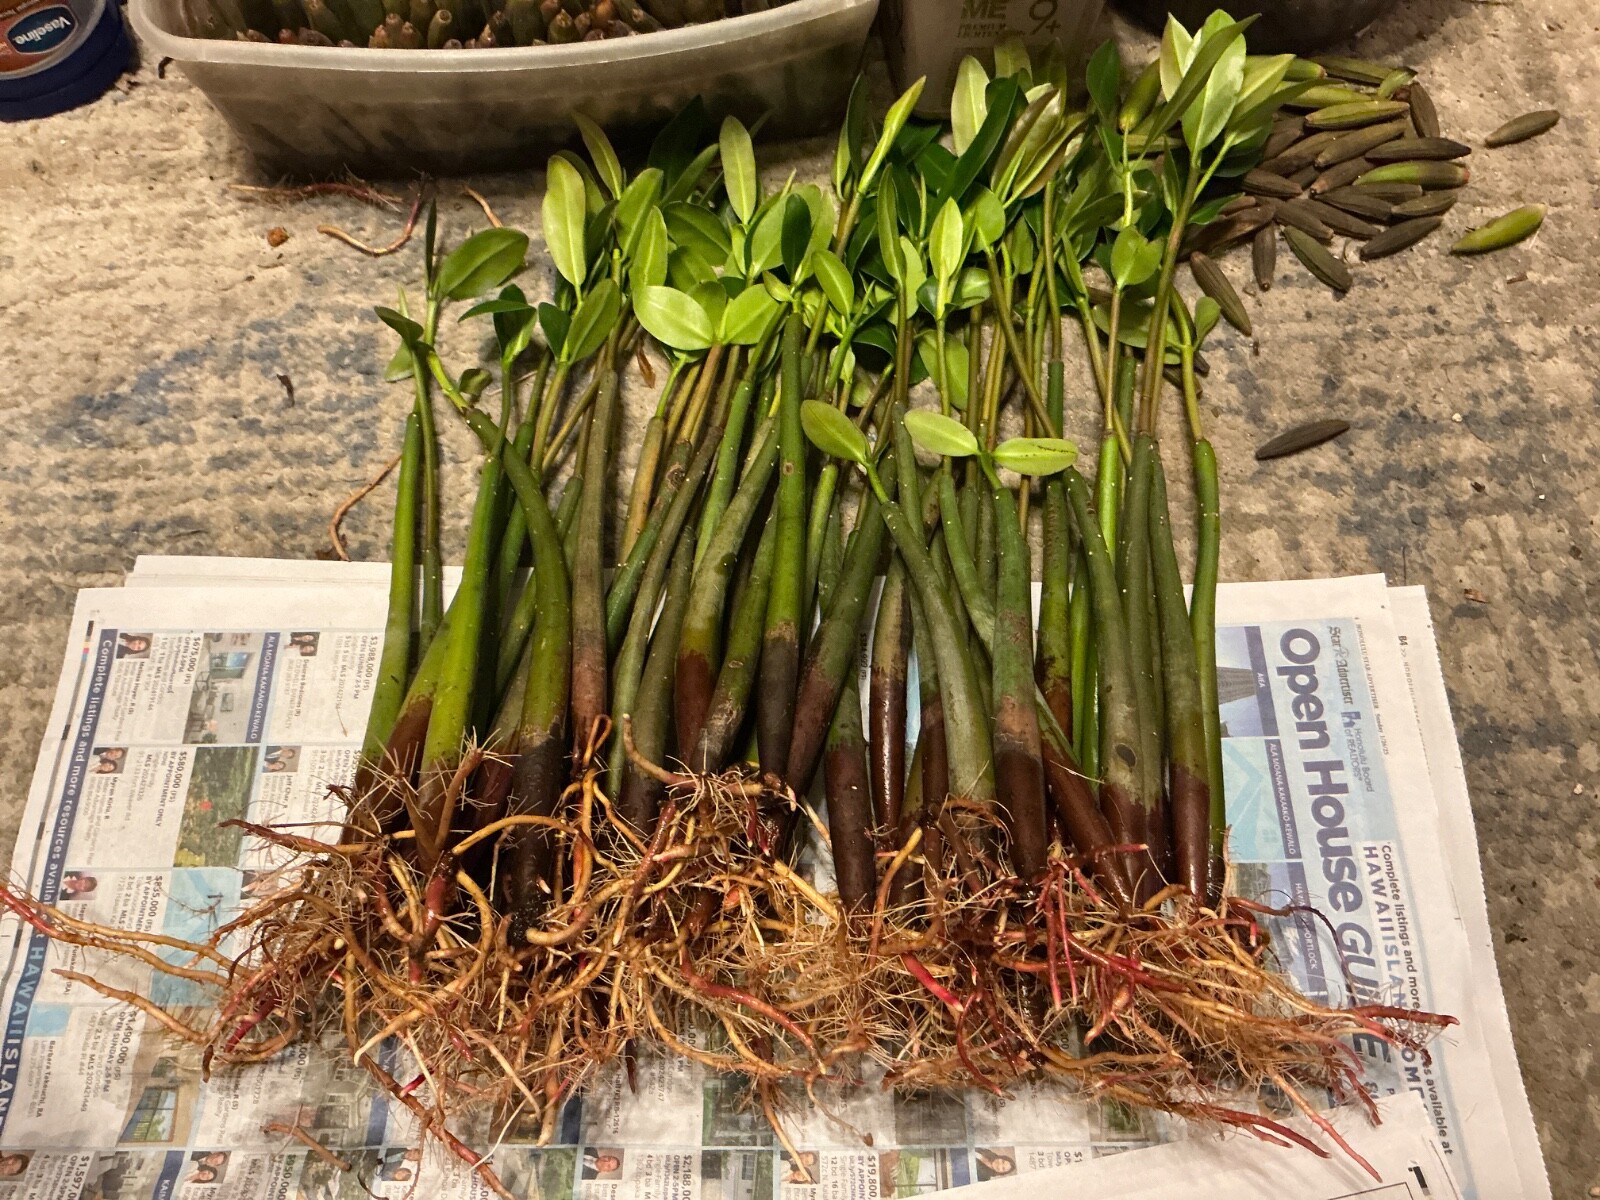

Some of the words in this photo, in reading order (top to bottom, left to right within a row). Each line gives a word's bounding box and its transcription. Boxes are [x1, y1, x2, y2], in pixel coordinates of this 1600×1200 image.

[15, 16, 72, 45] Vaseline
[182, 637, 191, 654] OPEN
[267, 636, 276, 648] ALA
[359, 636, 368, 652] OPEN
[187, 637, 201, 672] $675,000
[364, 636, 378, 678] $3,988,000
[92, 640, 112, 694] Complete
[154, 667, 163, 679] MLS
[340, 664, 348, 678] MLS
[356, 654, 365, 678] SUNDAY
[1328, 626, 1342, 648] Star
[1335, 660, 1354, 705] Advertiser
[183, 674, 192, 685] (FS)
[362, 680, 370, 691] (FS)
[1256, 672, 1265, 688] AIEA
[1276, 628, 1331, 750] Open
[353, 690, 360, 700] PM
[80, 697, 102, 738] listings
[1344, 729, 1352, 738] of
[75, 741, 90, 762] and
[342, 750, 350, 768] OPEN
[1270, 743, 1279, 756] ALA
[144, 754, 153, 767] MLS
[172, 751, 188, 788] $580,000
[1355, 729, 1367, 766] Honolulu
[1362, 768, 1374, 792] Board
[67, 766, 82, 796] more
[159, 760, 175, 807] APPOINTMENT
[286, 775, 294, 786] Jeff
[169, 790, 177, 802] (FS)
[155, 808, 164, 827] ONLY
[51, 800, 72, 859] resources
[1303, 760, 1364, 913] House
[1381, 845, 1400, 900] Complete
[38, 864, 59, 920] availae
[118, 910, 127, 924] MLS
[135, 886, 150, 933] APPOINTMEN
[144, 918, 152, 932] (FS)
[1394, 904, 1413, 946] listings
[1404, 950, 1418, 972] and
[1409, 977, 1422, 1009] more
[116, 1012, 126, 1031] OPEN
[94, 1029, 102, 1040] 2.5
[116, 1010, 137, 1064] $1,490,000
[46, 1040, 56, 1070] Barbara
[106, 1033, 120, 1064] SUNDAY
[88, 1054, 96, 1070] MLS
[292, 1068, 301, 1080] (FS)
[102, 1080, 110, 1092] PM
[36, 1108, 44, 1118] RA
[1427, 1079, 1448, 1138] available
[1442, 1141, 1453, 1155] at
[65, 1156, 78, 1176] OPEN
[672, 1155, 680, 1174] OPEN
[858, 1156, 864, 1166] BY
